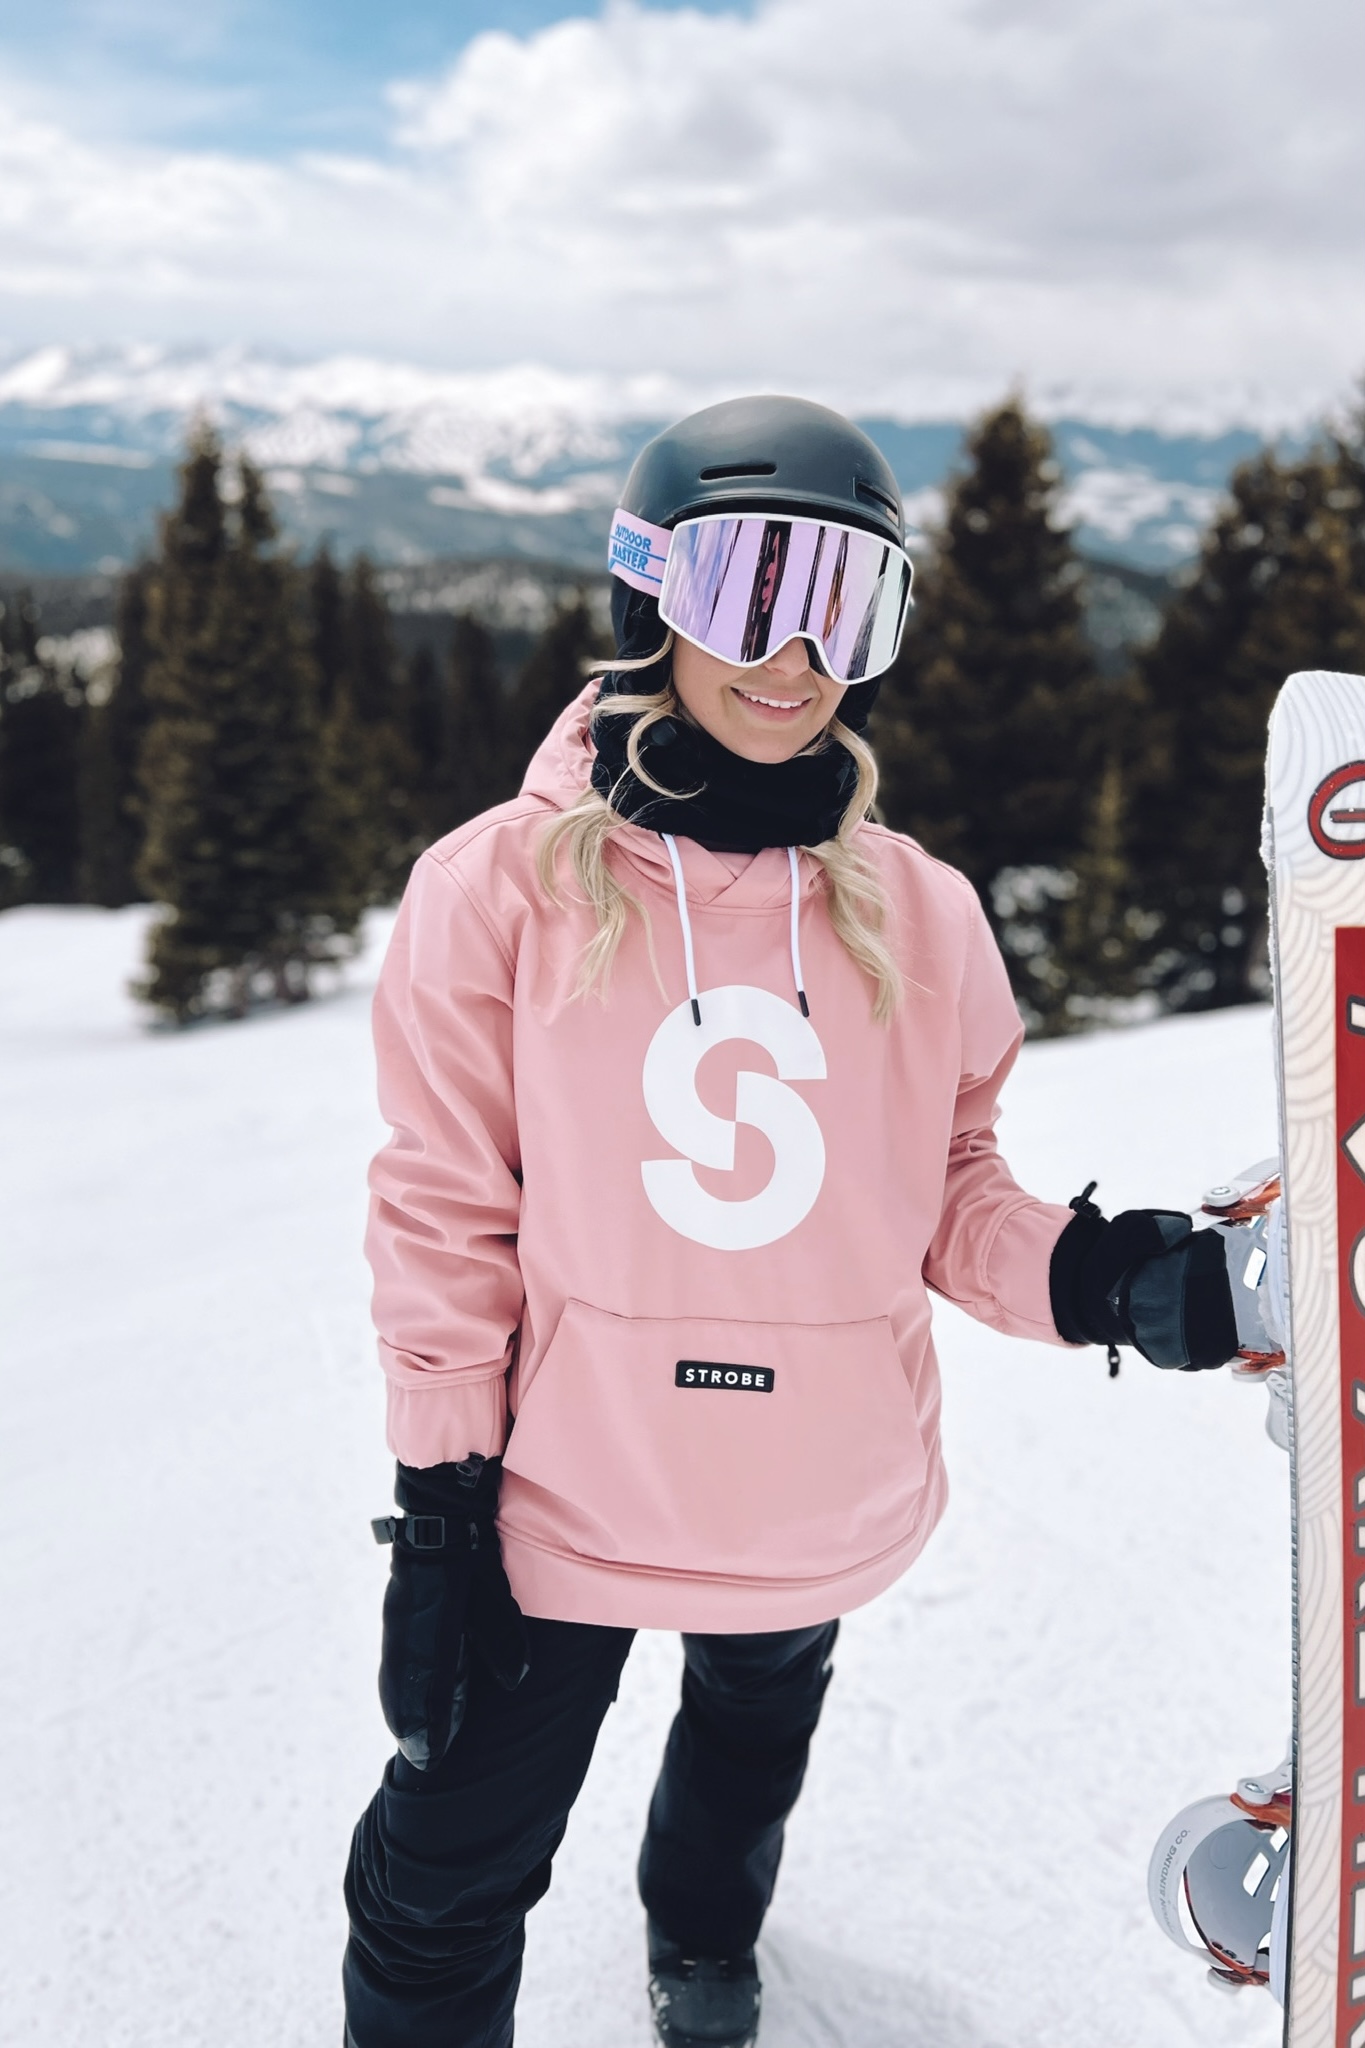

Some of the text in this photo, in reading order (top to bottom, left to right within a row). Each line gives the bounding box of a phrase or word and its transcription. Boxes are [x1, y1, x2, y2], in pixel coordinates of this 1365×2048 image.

[615, 523, 652, 552] OUTDOOR
[612, 542, 649, 572] MASTER
[640, 984, 828, 1251] S
[685, 1368, 766, 1388] STROBE
